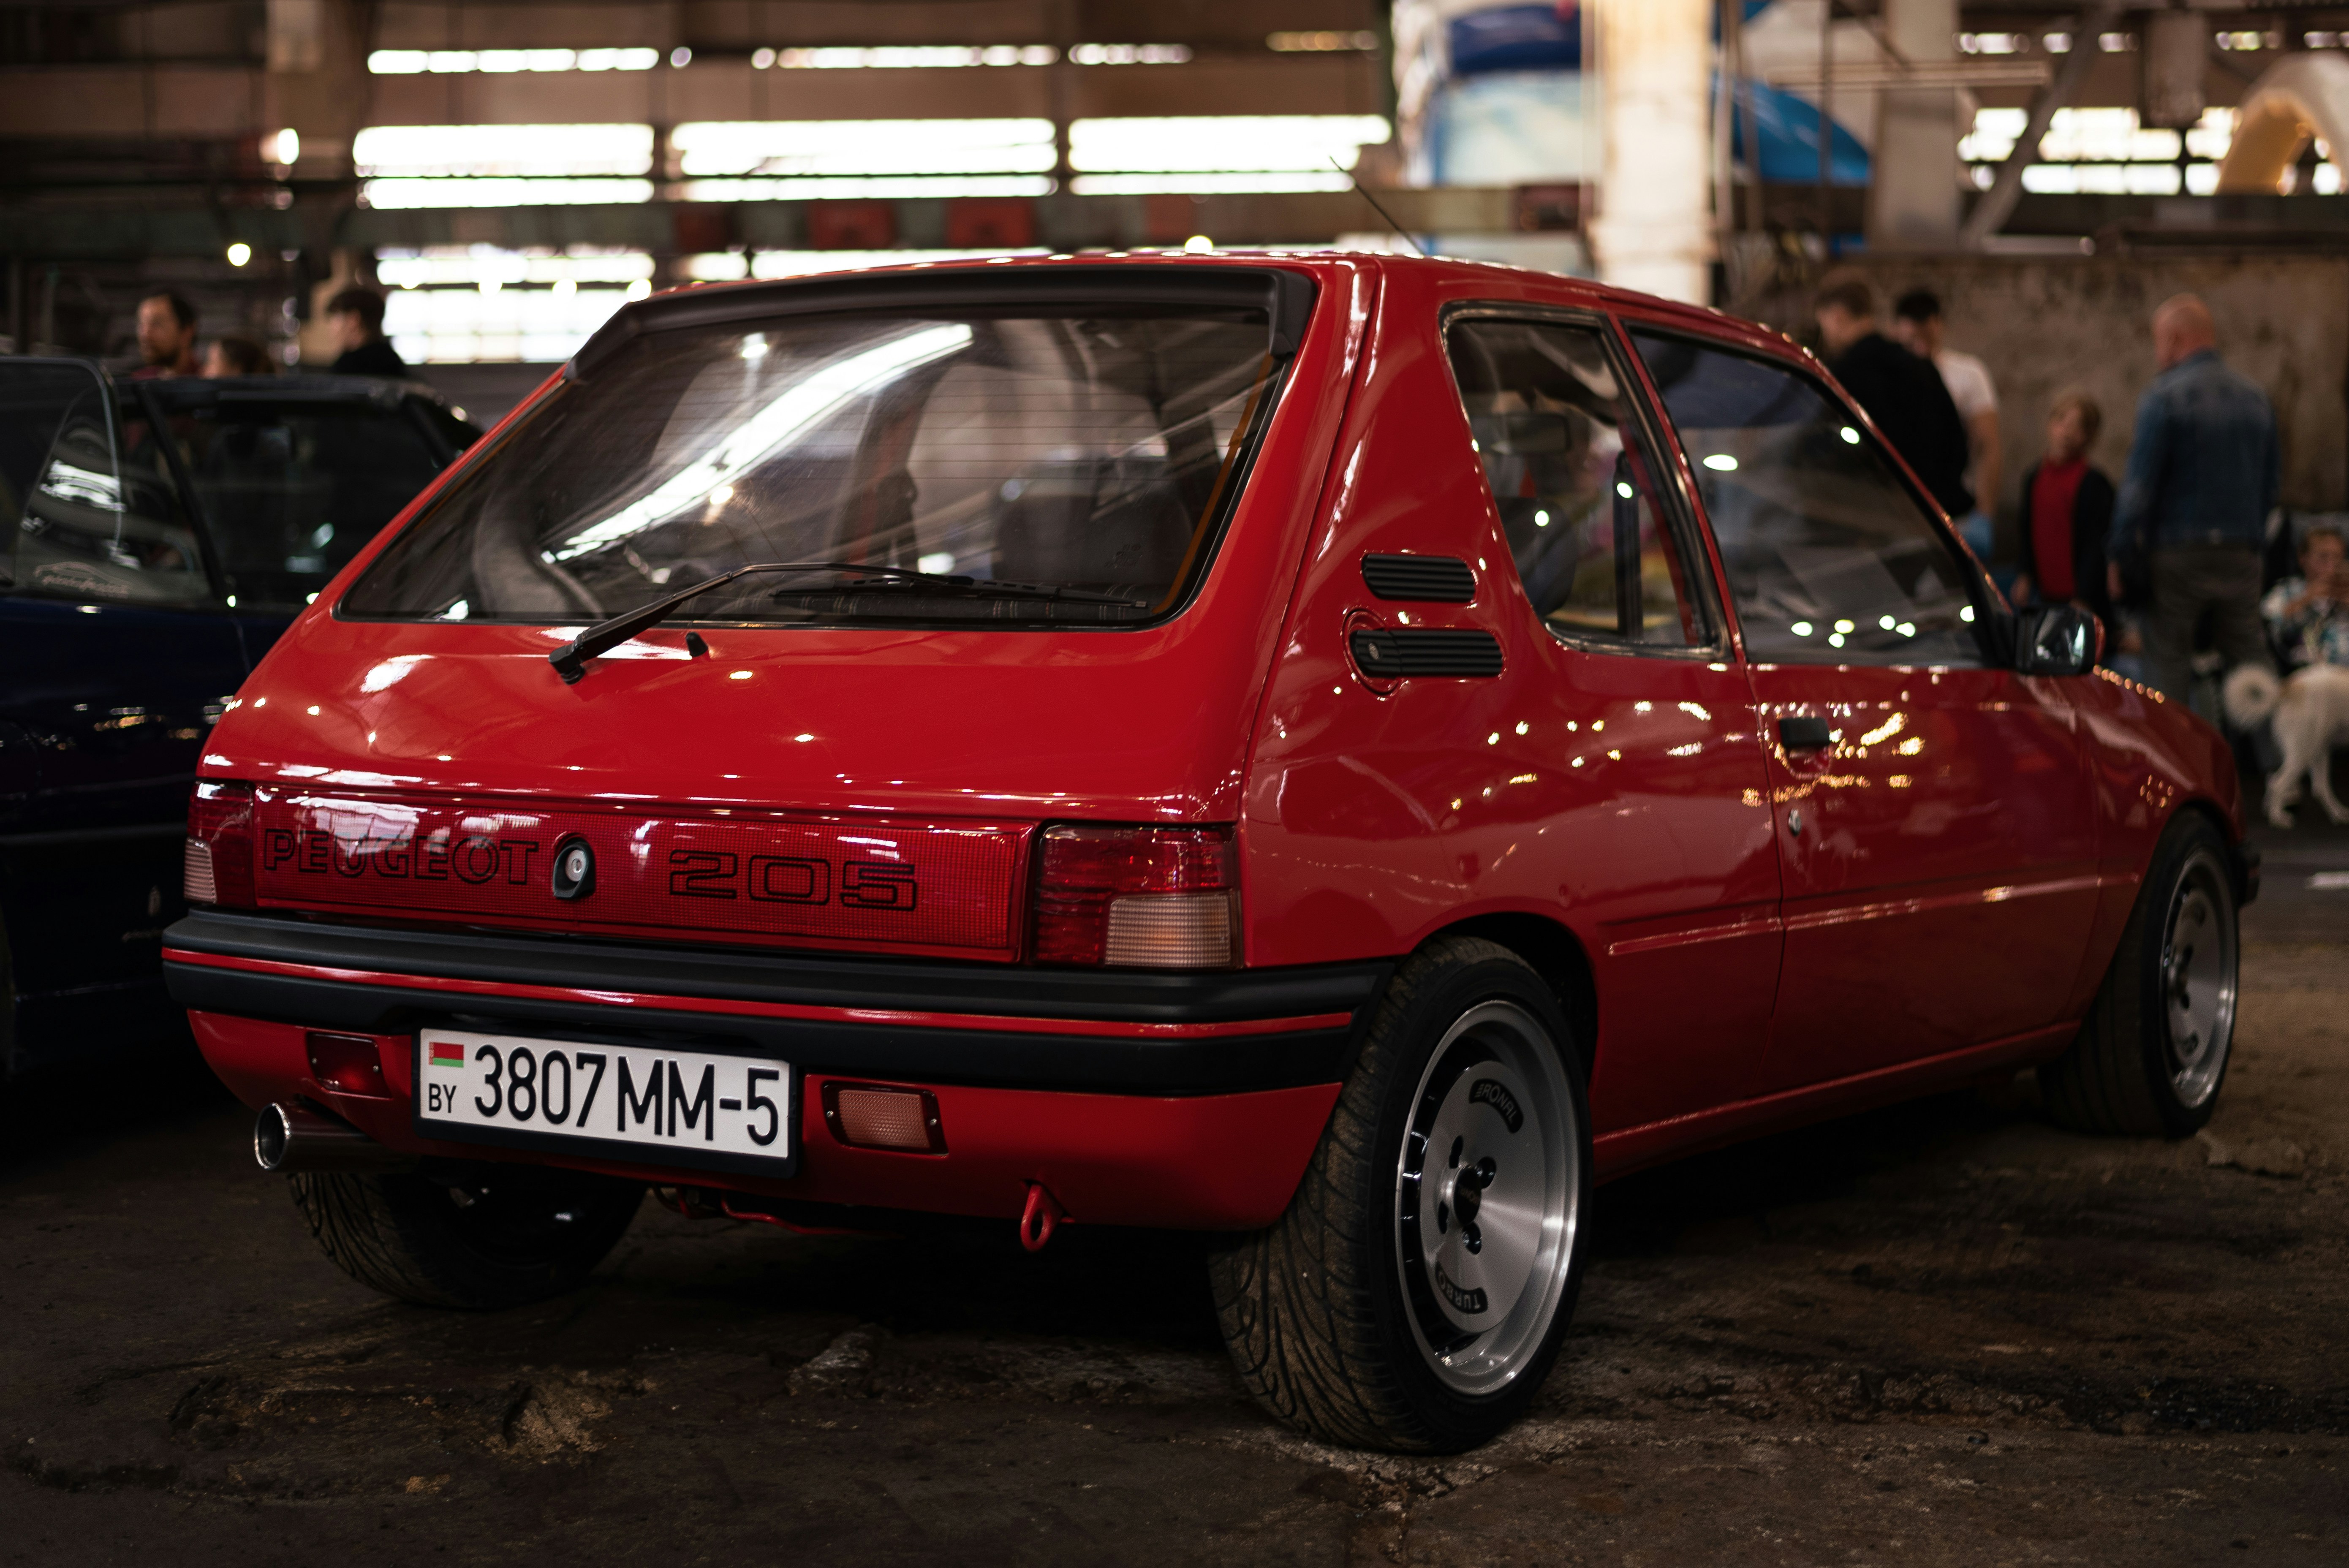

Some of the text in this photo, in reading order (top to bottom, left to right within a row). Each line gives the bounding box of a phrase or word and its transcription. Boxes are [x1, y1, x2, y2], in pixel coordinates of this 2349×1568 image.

[264, 829, 916, 911] PEUGEOT 205
[428, 1083, 457, 1114] BY
[474, 1044, 780, 1147] 3807 MM-5
[1480, 1083, 1517, 1125] RONAL
[1438, 1270, 1481, 1310] TURBO
